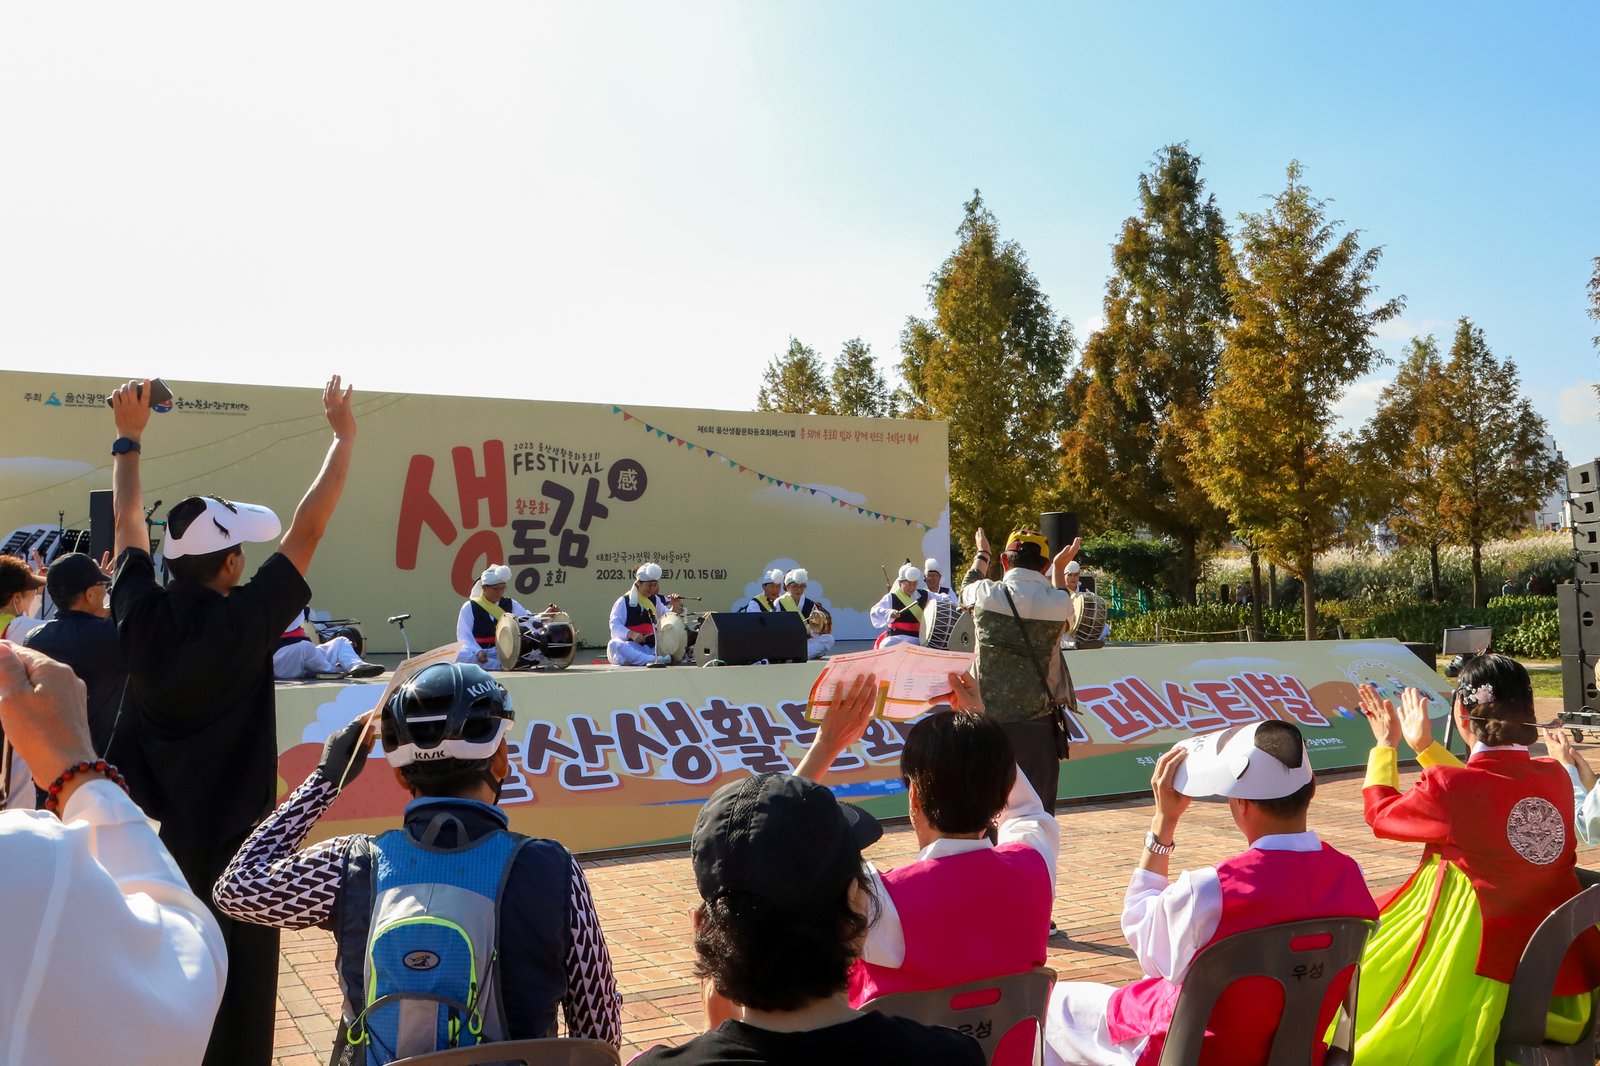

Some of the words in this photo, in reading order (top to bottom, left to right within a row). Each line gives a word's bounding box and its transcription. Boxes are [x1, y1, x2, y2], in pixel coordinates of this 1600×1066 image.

[24, 392, 42, 402] 주최
[65, 392, 106, 404] 울산광역
[697, 425, 715, 434] 제6회
[513, 442, 534, 451] 2023
[513, 452, 604, 476] FESTIVAL
[617, 468, 638, 491] 感
[515, 497, 550, 516] 활문화
[395, 439, 508, 598] 생
[541, 477, 609, 569] 감
[508, 519, 551, 595] 동
[596, 551, 651, 563] 태화강국가정원
[544, 568, 566, 588] 호회
[596, 569, 626, 580] 2023.
[1076, 672, 1330, 741] 페스티벌
[415, 750, 446, 760] KASK
[1292, 962, 1324, 981] 우성
